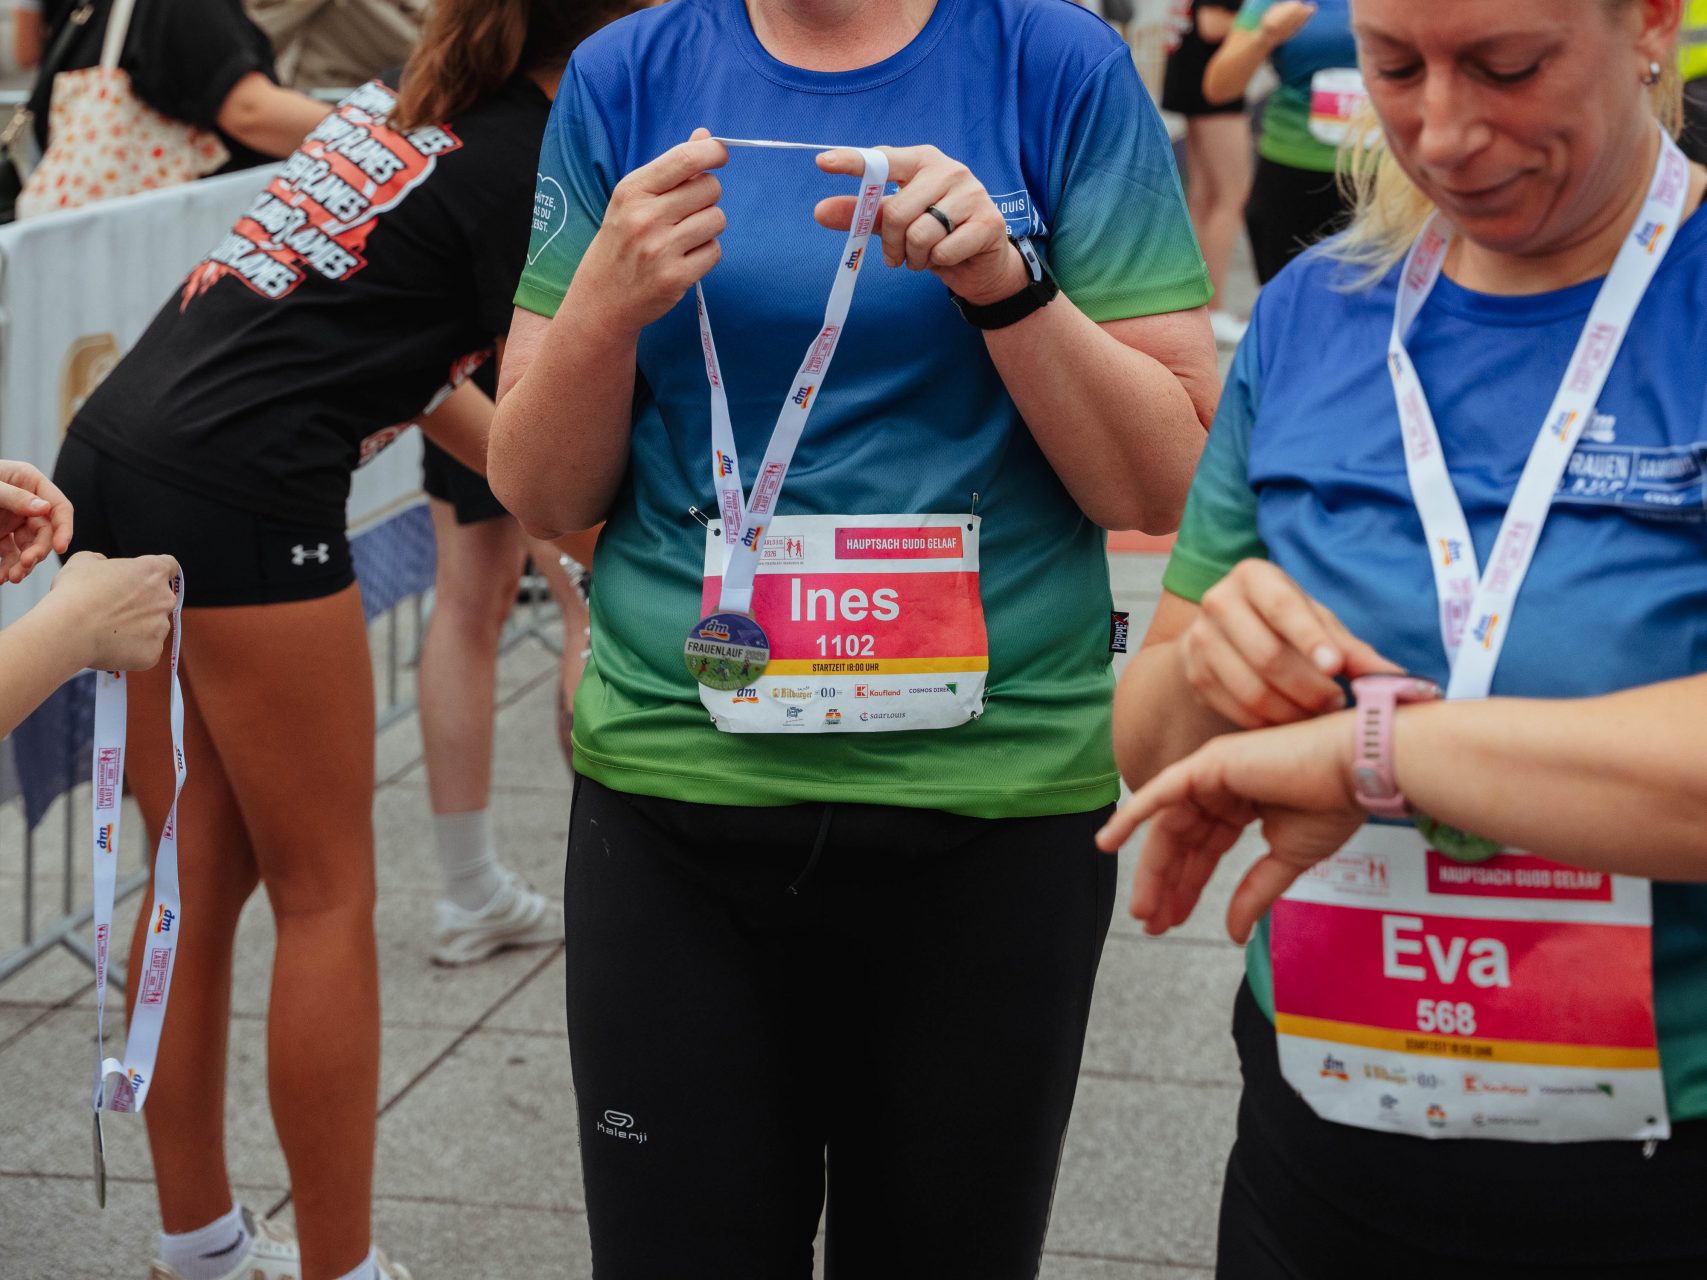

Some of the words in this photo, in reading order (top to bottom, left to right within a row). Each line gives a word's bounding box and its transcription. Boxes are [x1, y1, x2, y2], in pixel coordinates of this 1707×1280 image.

[541, 208, 551, 220] DU
[845, 251, 858, 269] dm
[792, 387, 808, 405] dm
[722, 454, 734, 474] dm
[1568, 453, 1631, 478] RAUEN
[741, 527, 756, 546] dm
[847, 539, 900, 549] HAUPTSACH
[902, 539, 926, 549] GUDD
[927, 538, 957, 549] GELAAF
[791, 578, 900, 621] Ines
[706, 621, 728, 632] dm
[688, 641, 744, 658] FRAUENLAUF
[816, 635, 875, 656] 1102
[812, 663, 845, 672] STARTZEIT
[847, 663, 864, 672] 18:00
[865, 663, 879, 671] UHR
[736, 687, 757, 697] dm
[781, 688, 813, 699] Bitburger
[869, 689, 901, 697] Kaufland
[97, 826, 107, 849] dm
[161, 909, 175, 931] dm
[151, 950, 160, 968] LAUF
[1382, 914, 1511, 988] Eva
[1417, 999, 1477, 1036] 568
